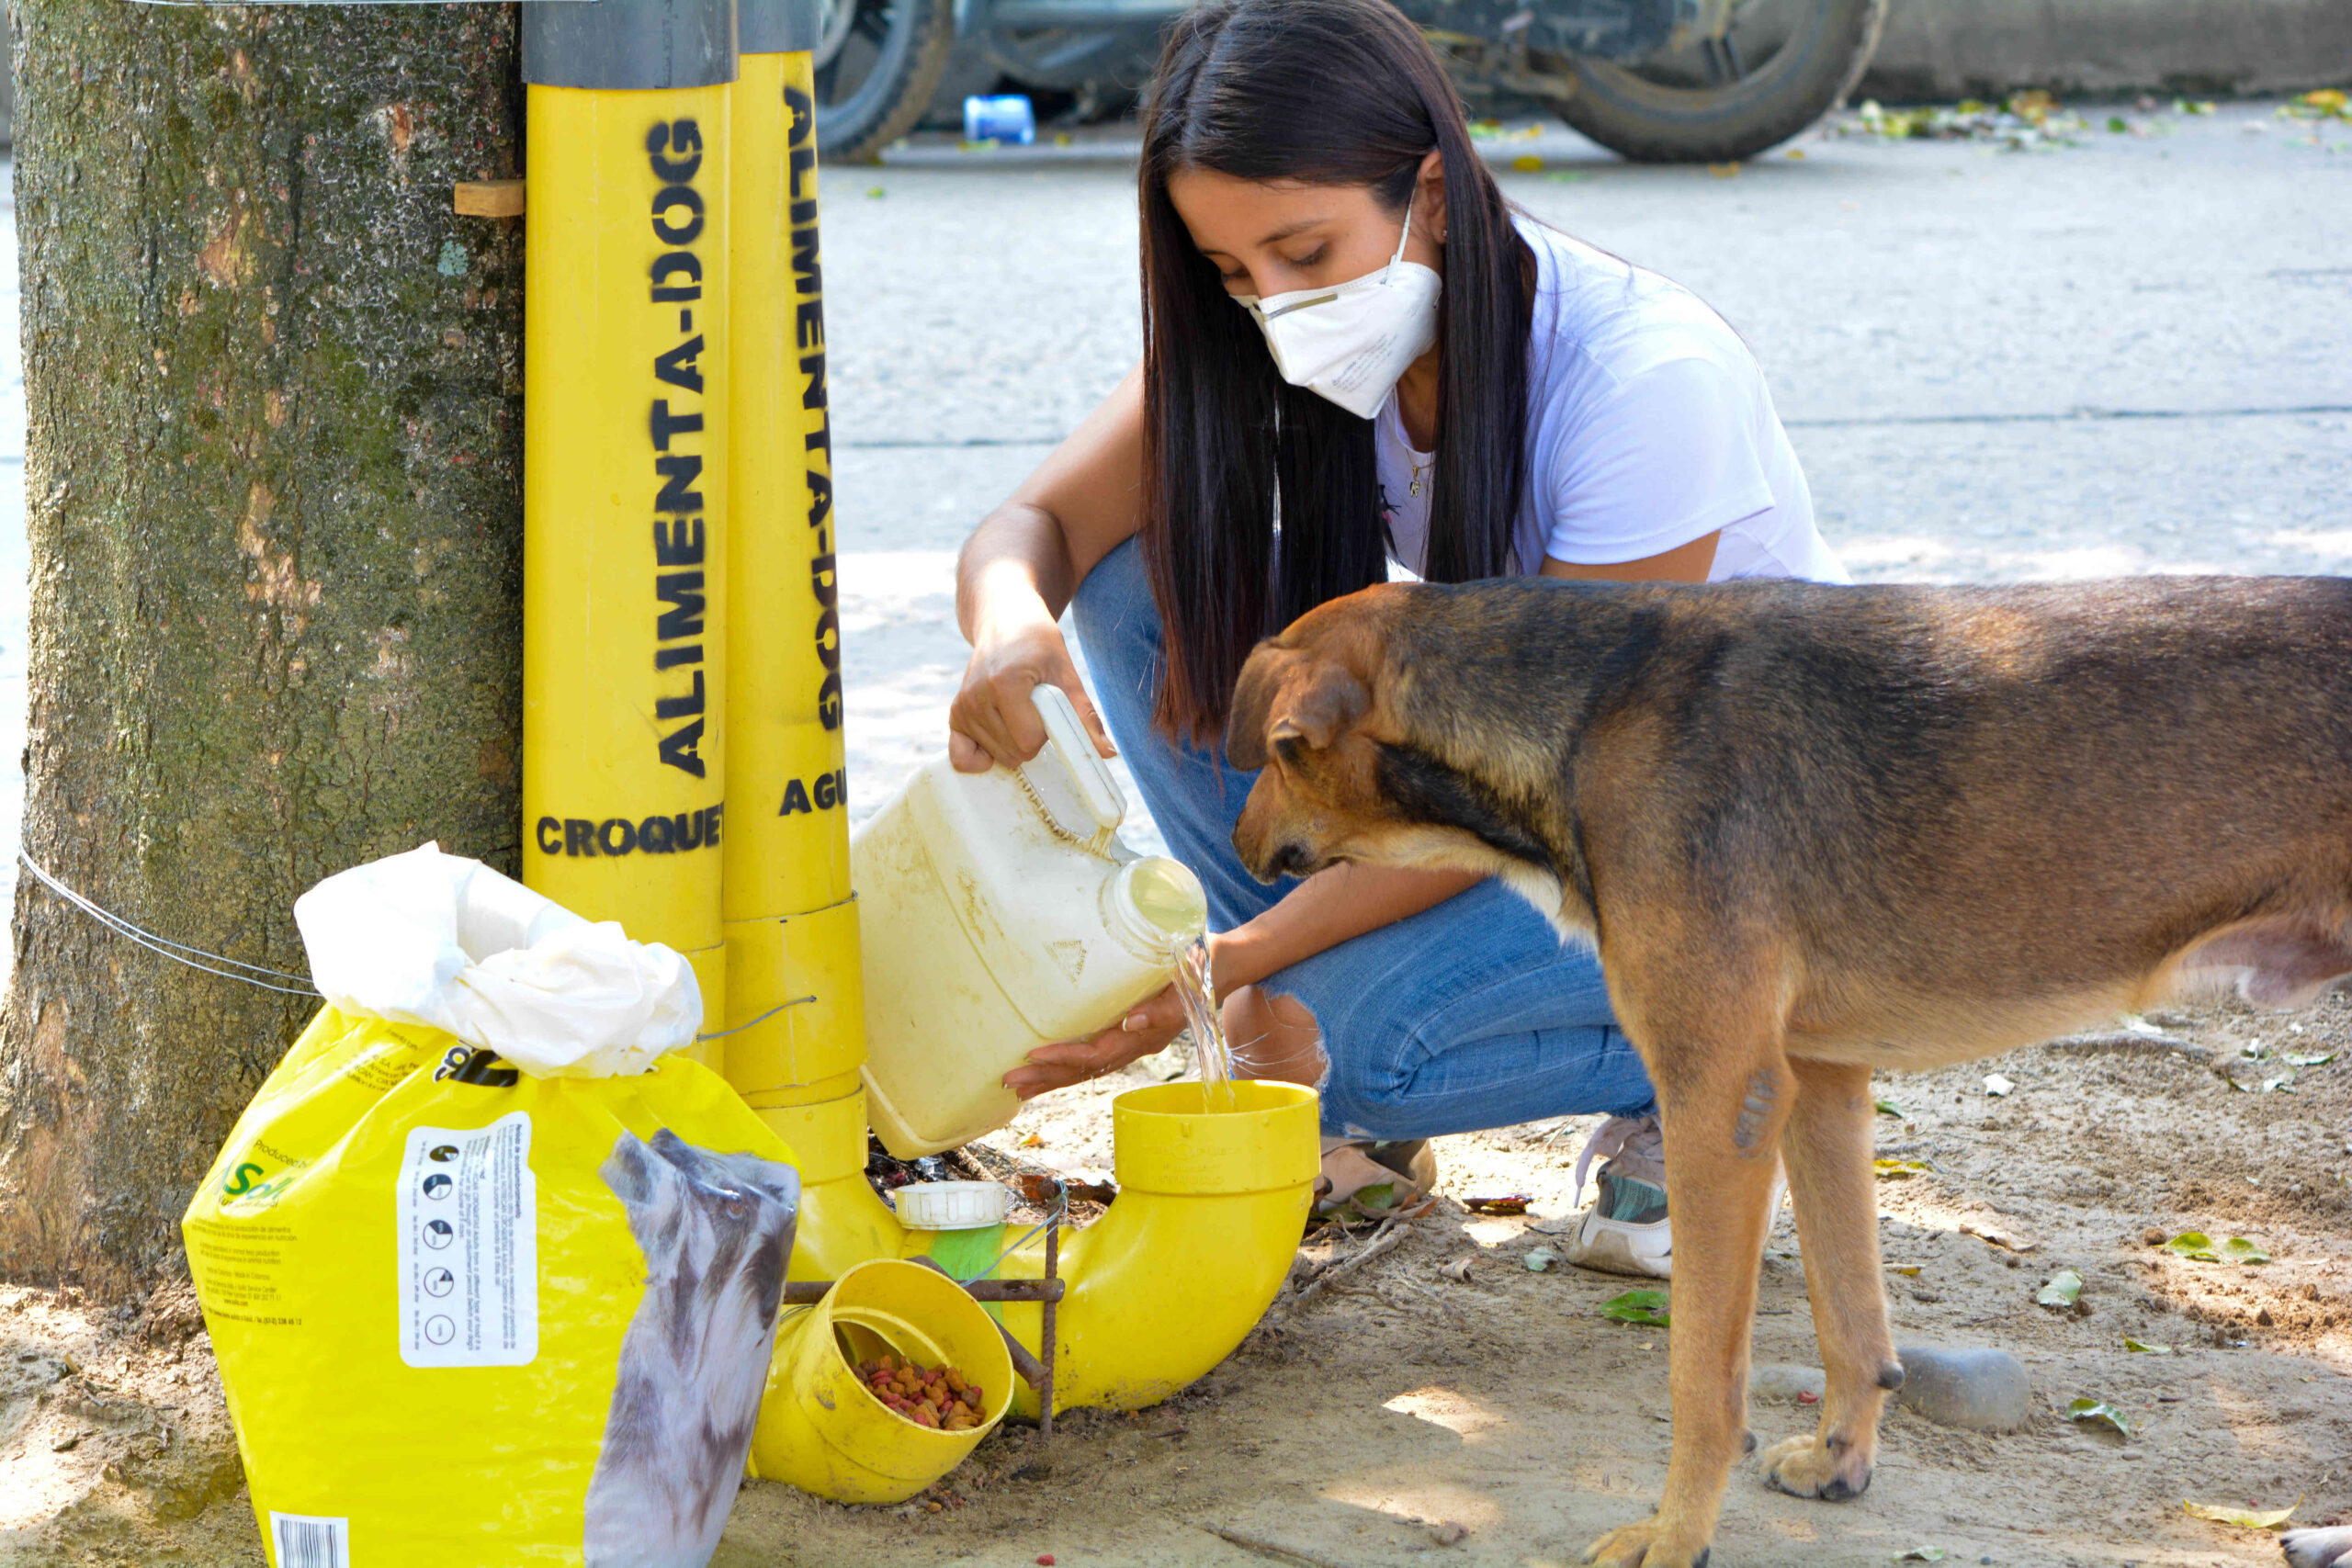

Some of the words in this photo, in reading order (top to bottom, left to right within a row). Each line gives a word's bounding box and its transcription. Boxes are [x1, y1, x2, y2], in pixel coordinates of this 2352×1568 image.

[647, 118, 706, 779] ALIMENTA-DOG
[783, 86, 843, 731] ALIMENTA-DOG
[537, 801, 724, 857] CROQUE
